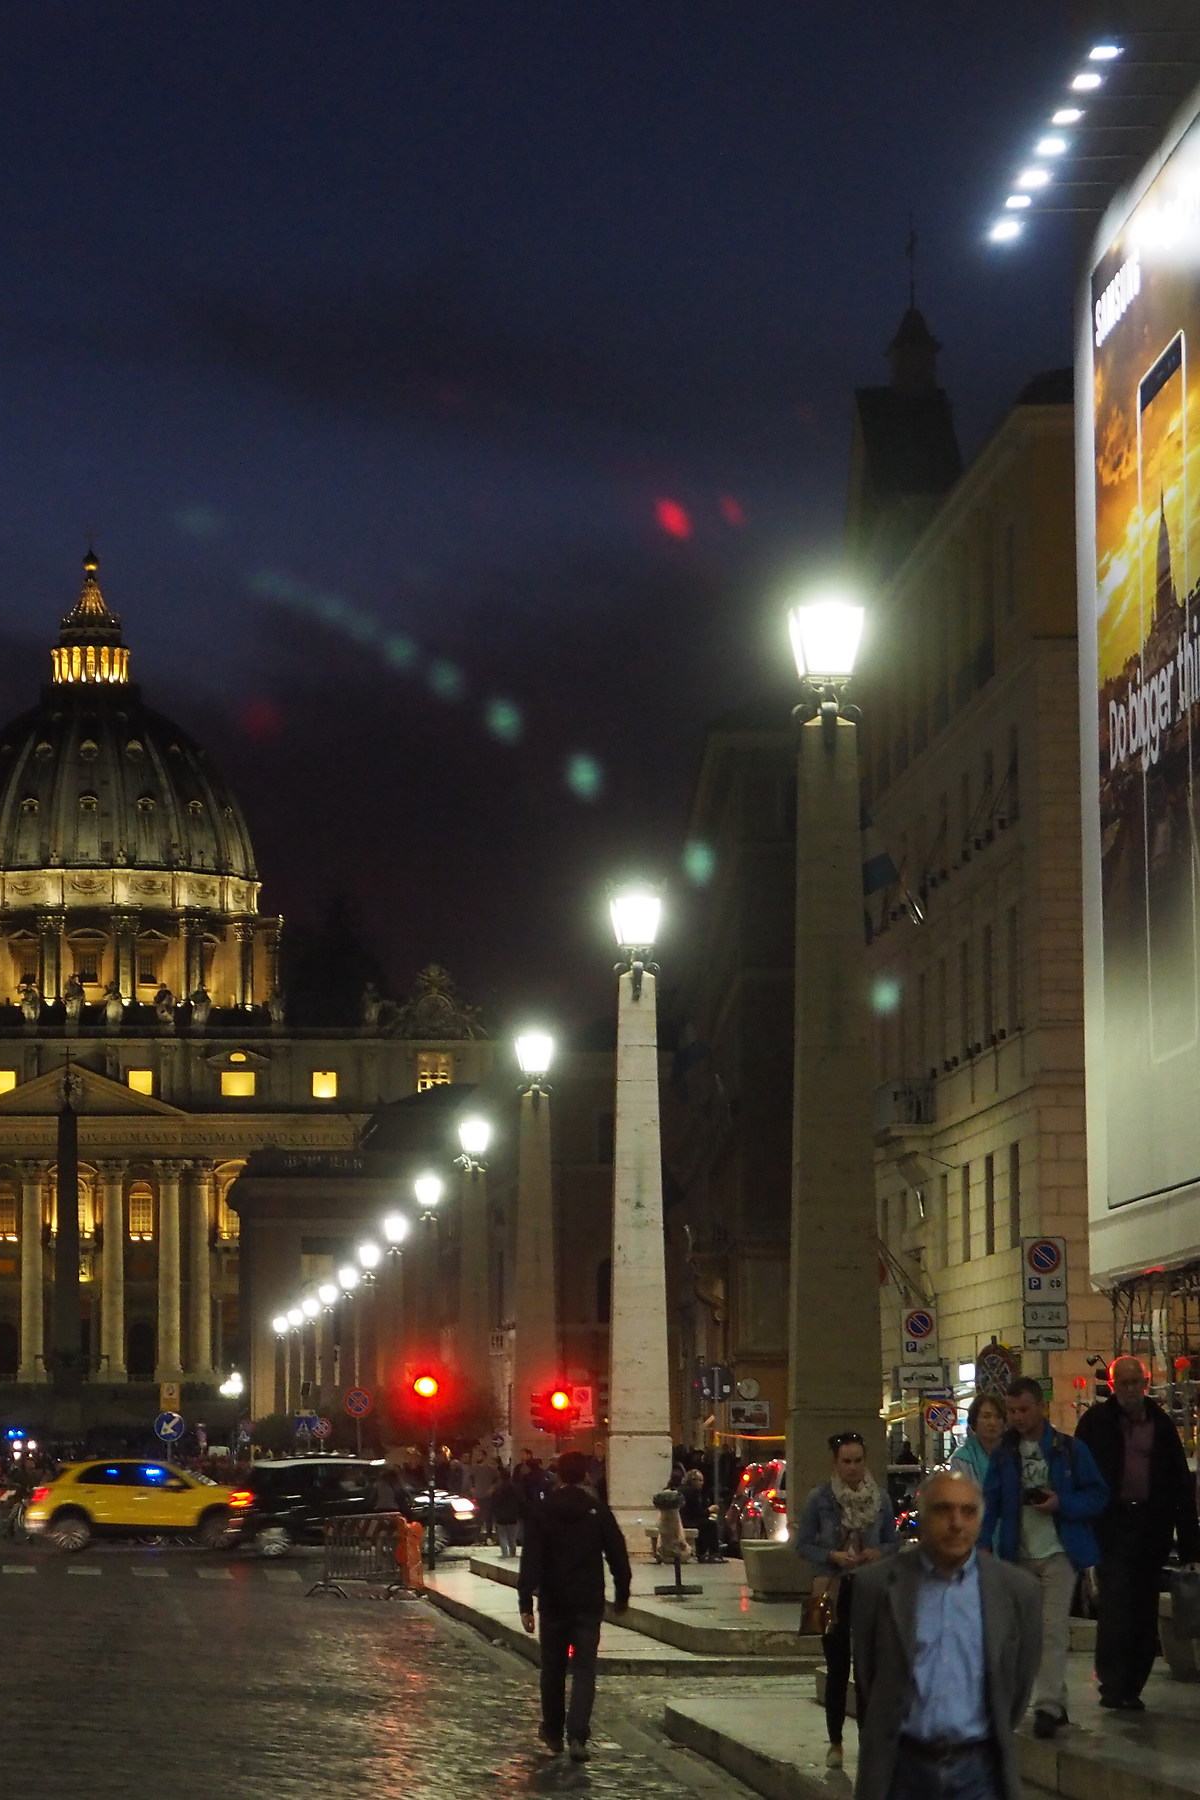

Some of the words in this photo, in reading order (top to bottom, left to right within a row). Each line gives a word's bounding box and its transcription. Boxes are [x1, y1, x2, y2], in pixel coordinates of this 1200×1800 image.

[1095, 246, 1140, 347] SAMSUNG
[1109, 699, 1127, 771] Do
[1128, 659, 1175, 773] bigger
[1176, 614, 1200, 716] thi
